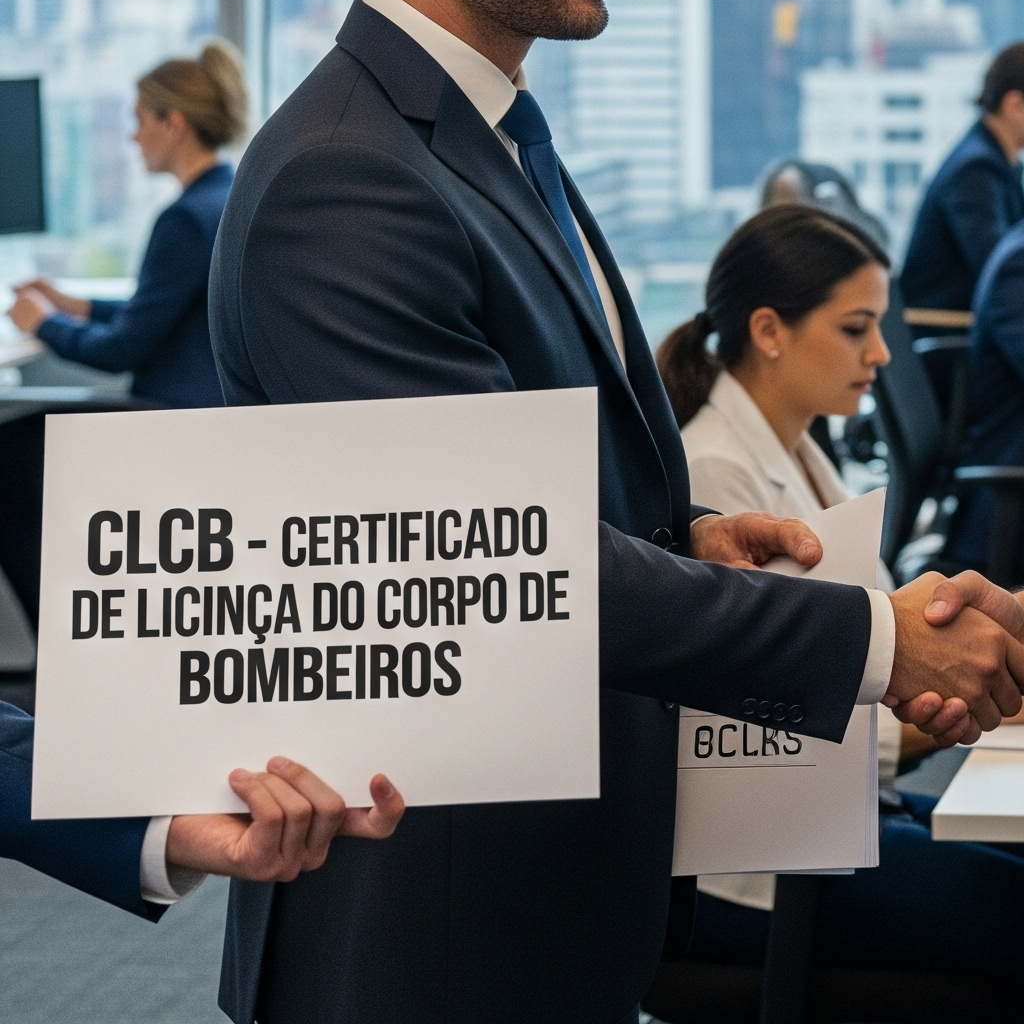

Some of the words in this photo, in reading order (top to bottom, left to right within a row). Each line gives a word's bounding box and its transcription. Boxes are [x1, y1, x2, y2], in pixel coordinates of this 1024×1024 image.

[87, 508, 234, 576] CLCB
[281, 505, 548, 568] CERTIFICADO
[71, 589, 126, 640] DE
[137, 583, 302, 645] LICINÇA
[312, 580, 365, 632] DO
[377, 573, 508, 630] CORPO
[519, 570, 570, 622] DE
[179, 640, 462, 706] BOMBEIROS
